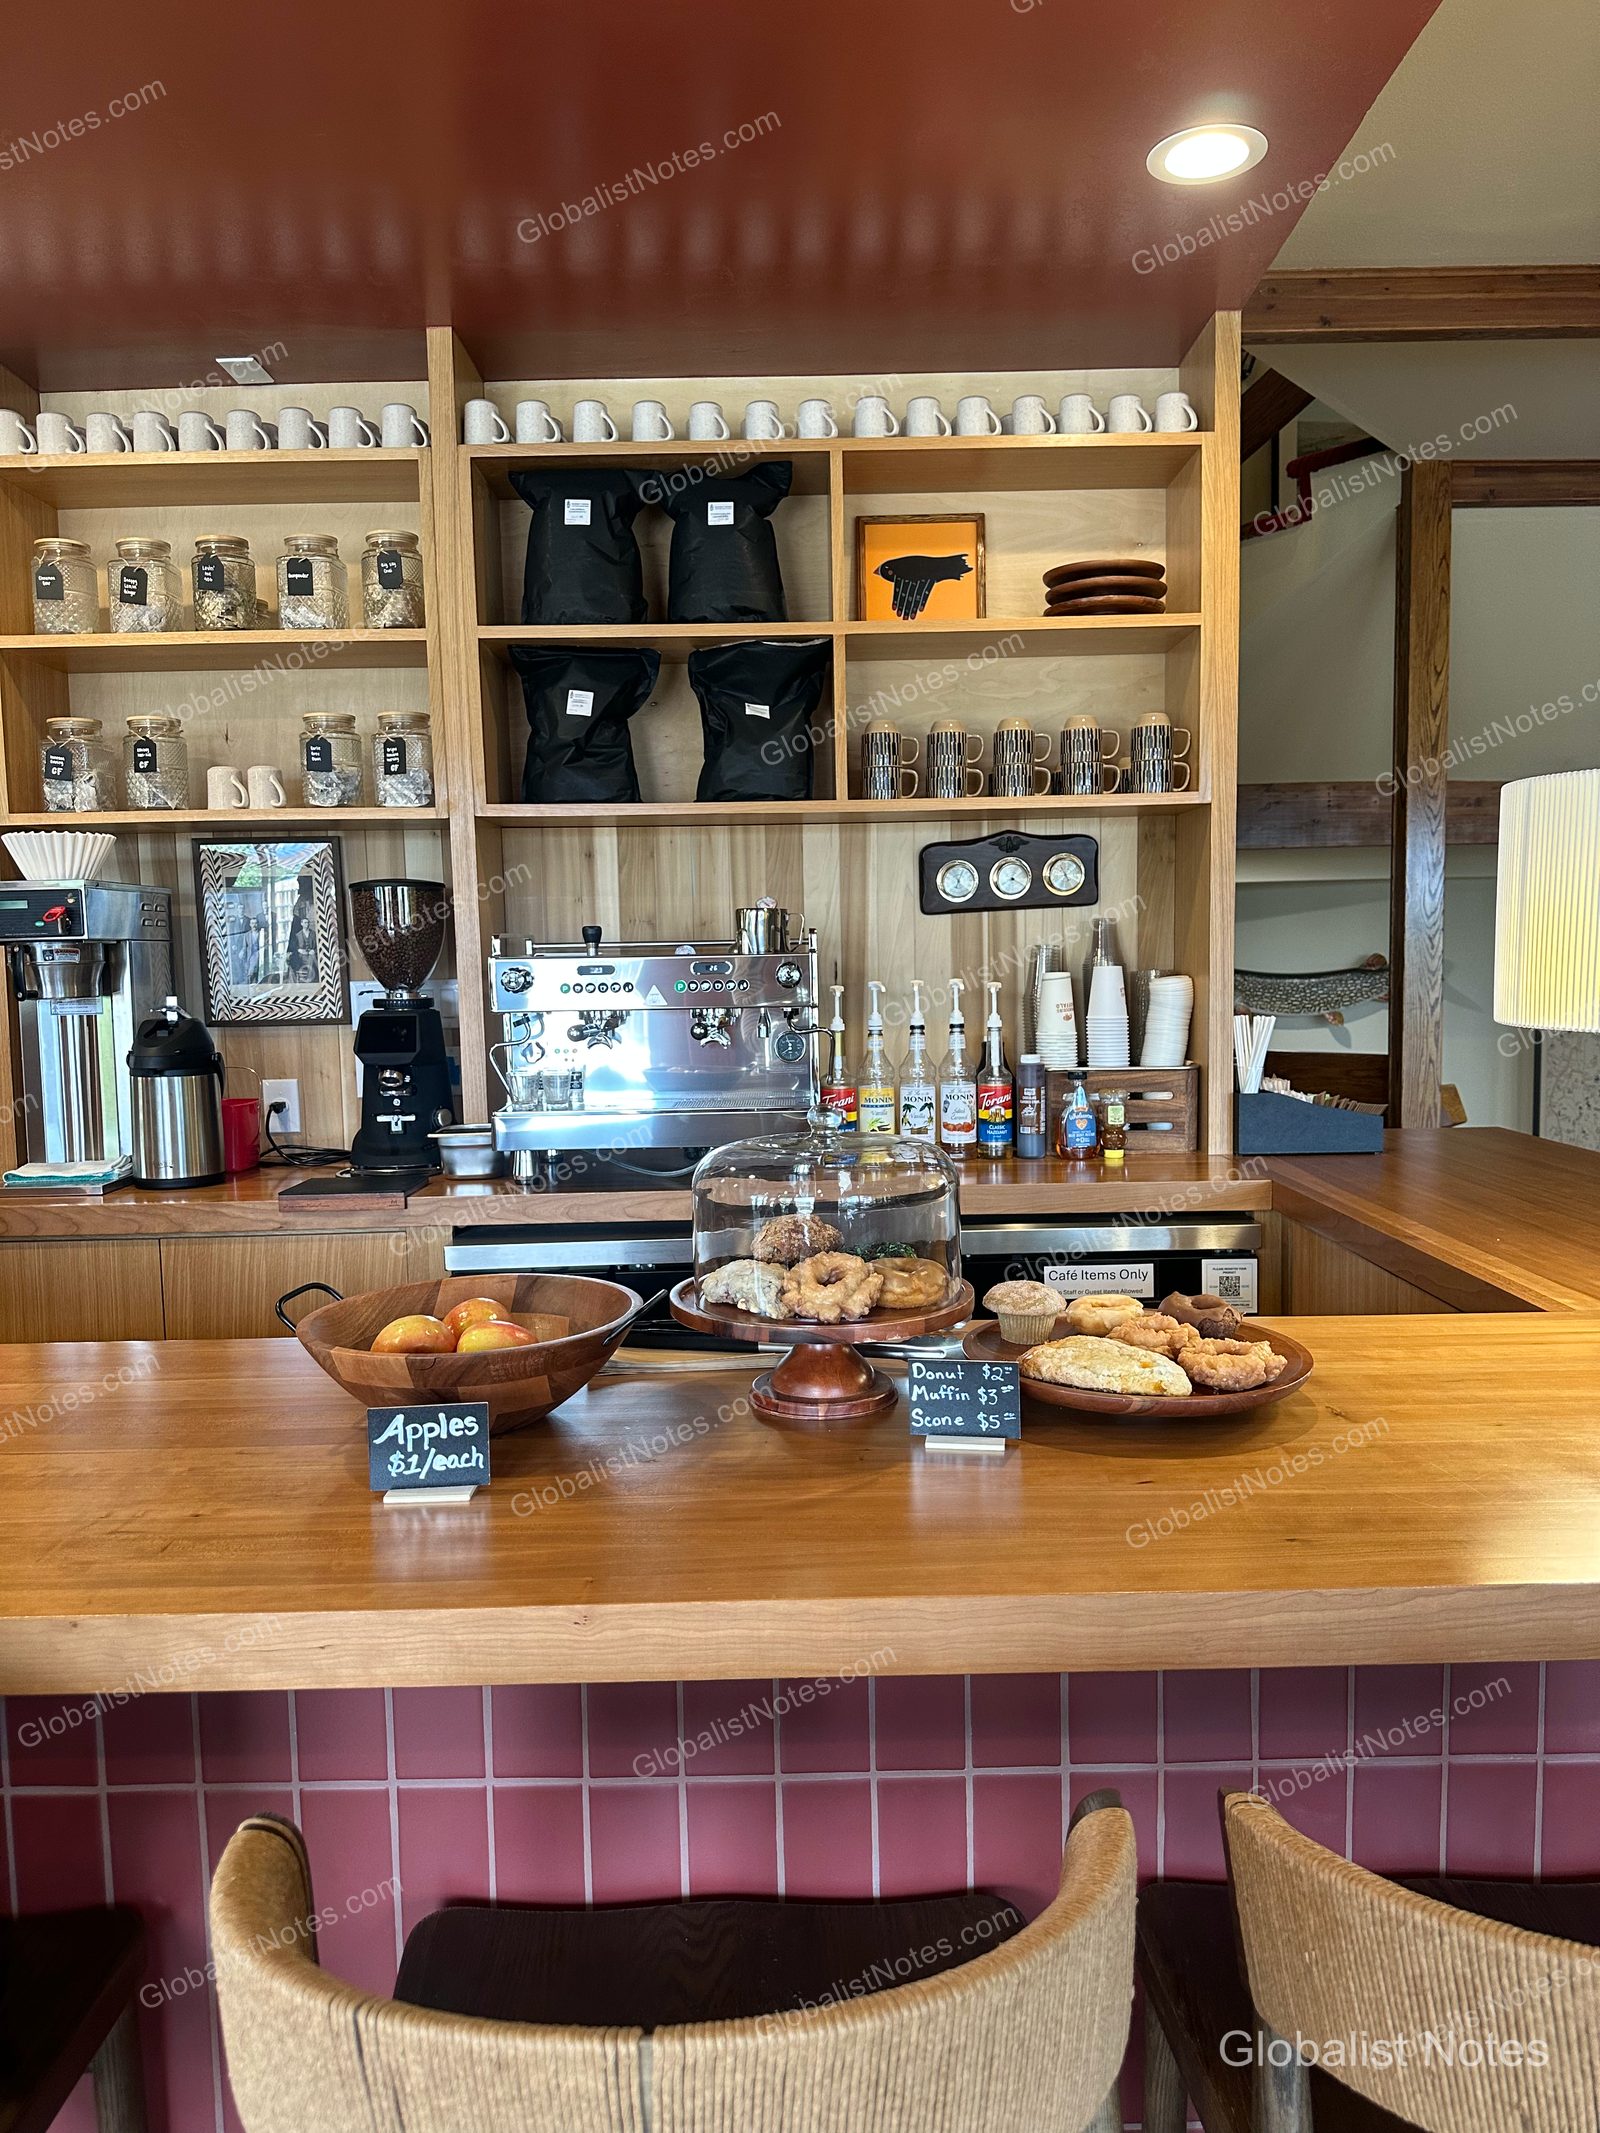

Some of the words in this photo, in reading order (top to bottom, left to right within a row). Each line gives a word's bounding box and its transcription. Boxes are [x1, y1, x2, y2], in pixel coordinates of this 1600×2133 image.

[864, 1096, 893, 1104] MONIN
[945, 1093, 975, 1101] MONIN
[979, 1090, 1012, 1111] Torani
[1048, 1269, 1078, 1281] Café
[1081, 1270, 1117, 1281] Items
[1120, 1269, 1149, 1282] Only
[911, 1362, 965, 1380] Donut
[911, 1384, 971, 1401] Muffin
[911, 1408, 965, 1428] Scone
[372, 1412, 480, 1453] Apples
[387, 1445, 485, 1480] $1/each
